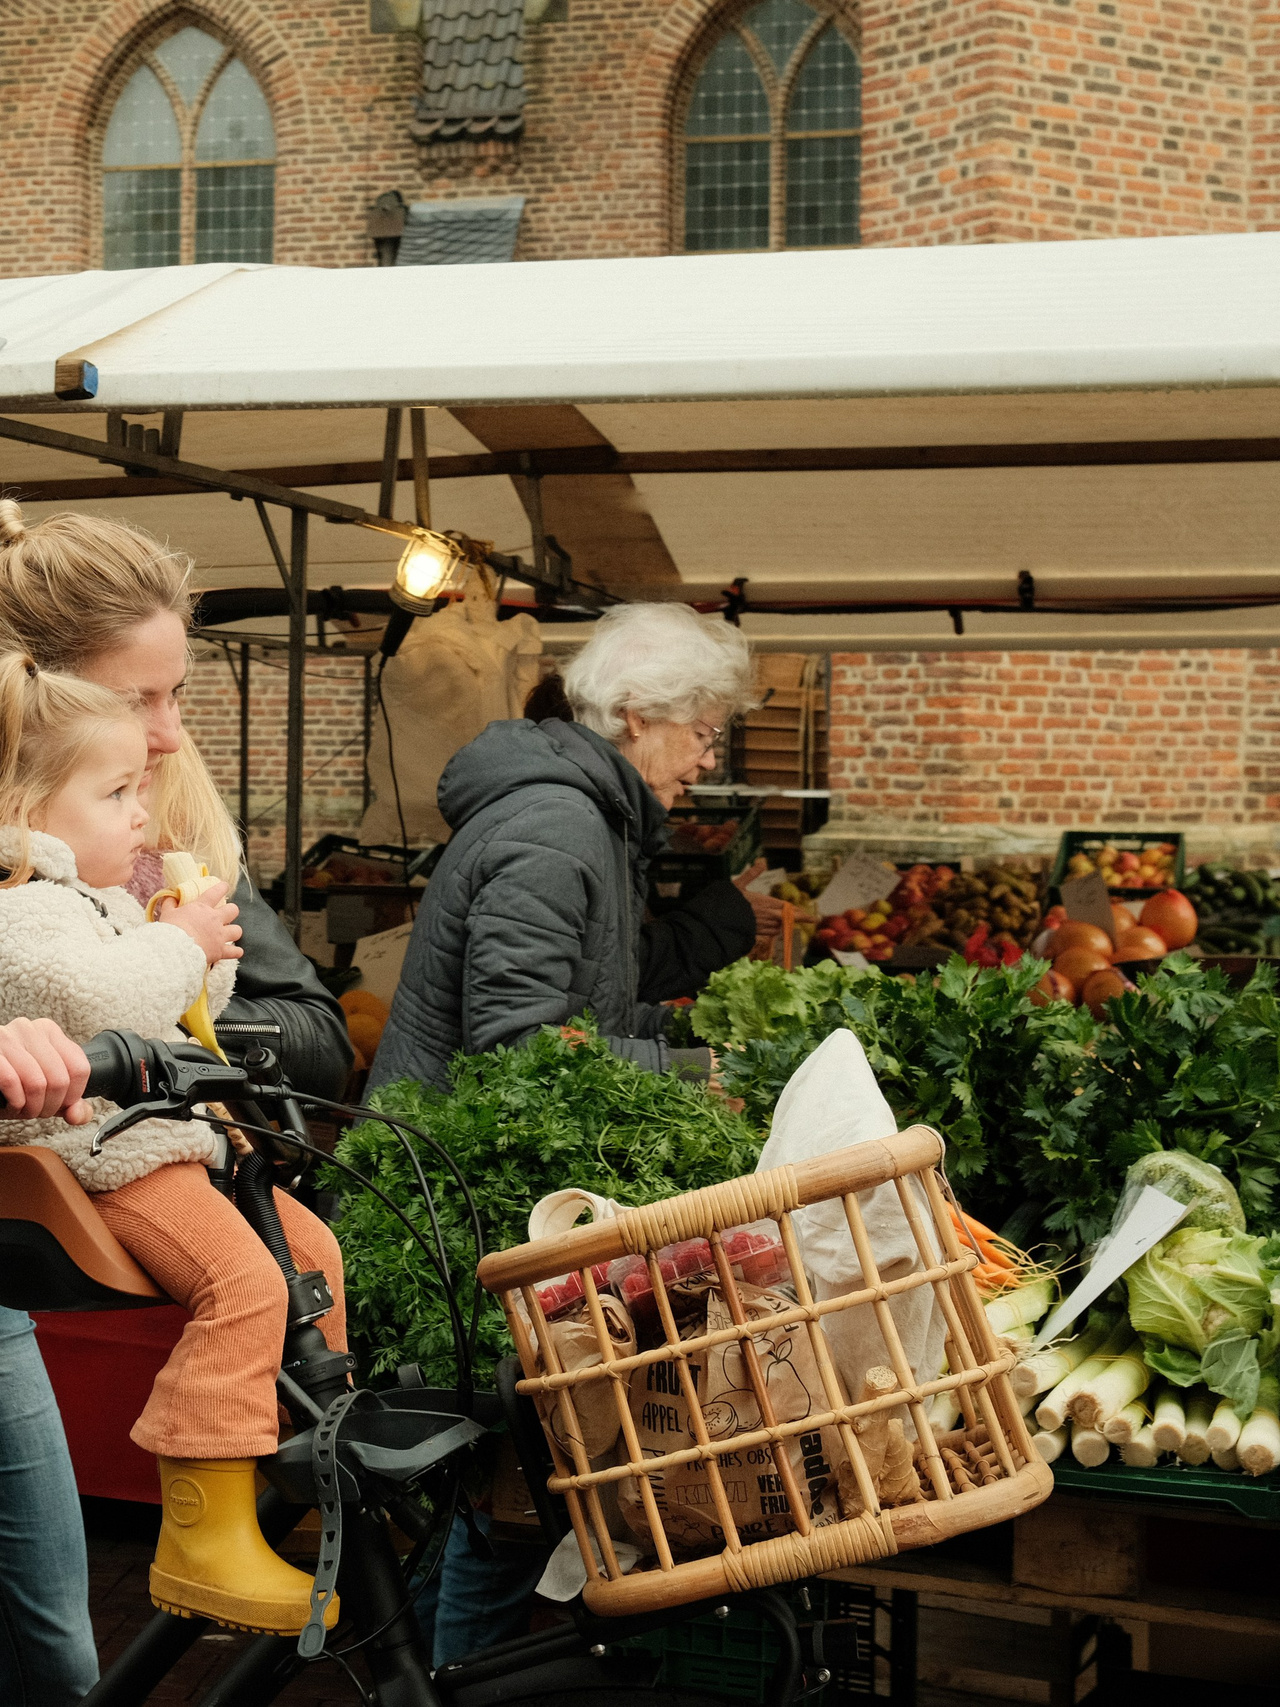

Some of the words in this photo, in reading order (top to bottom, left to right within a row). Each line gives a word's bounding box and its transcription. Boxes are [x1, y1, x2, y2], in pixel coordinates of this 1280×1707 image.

[647, 1360, 702, 1397] FRUT
[642, 1401, 684, 1434] APPEL
[746, 1447, 774, 1466] OBS
[757, 1474, 784, 1493] VER
[760, 1492, 802, 1515] FRU
